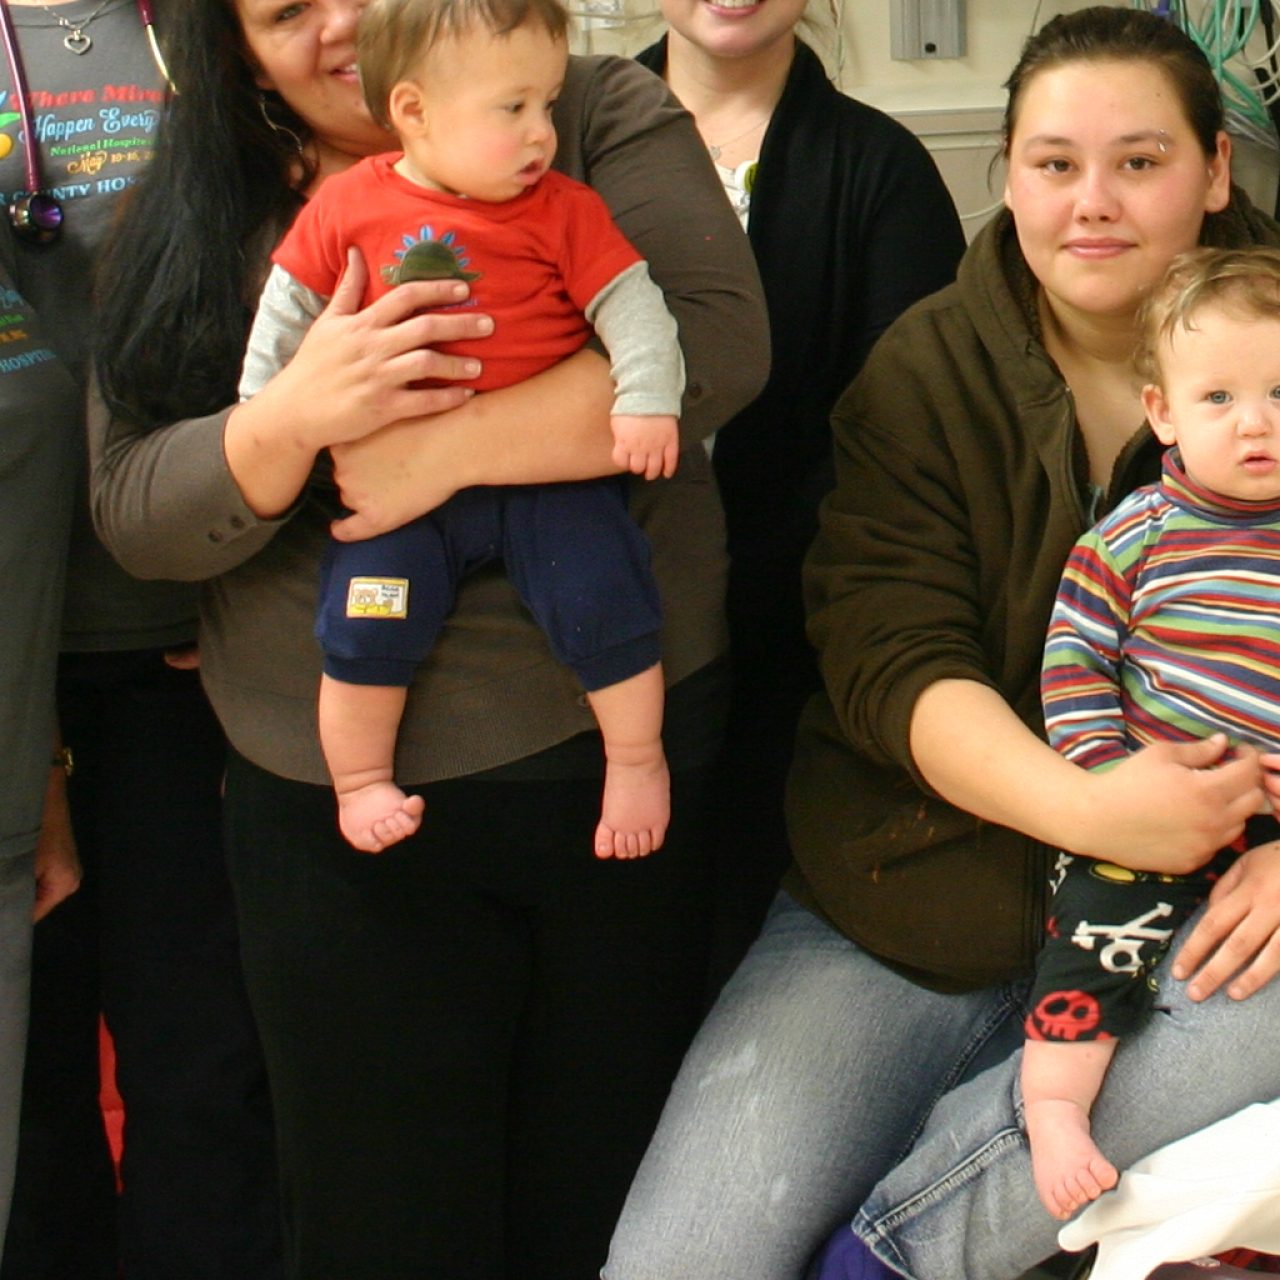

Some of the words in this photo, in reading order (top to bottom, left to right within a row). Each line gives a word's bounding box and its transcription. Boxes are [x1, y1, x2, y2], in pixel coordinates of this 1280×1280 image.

[102, 85, 162, 102] Mira
[50, 139, 101, 157] National
[102, 135, 151, 152] Hospita
